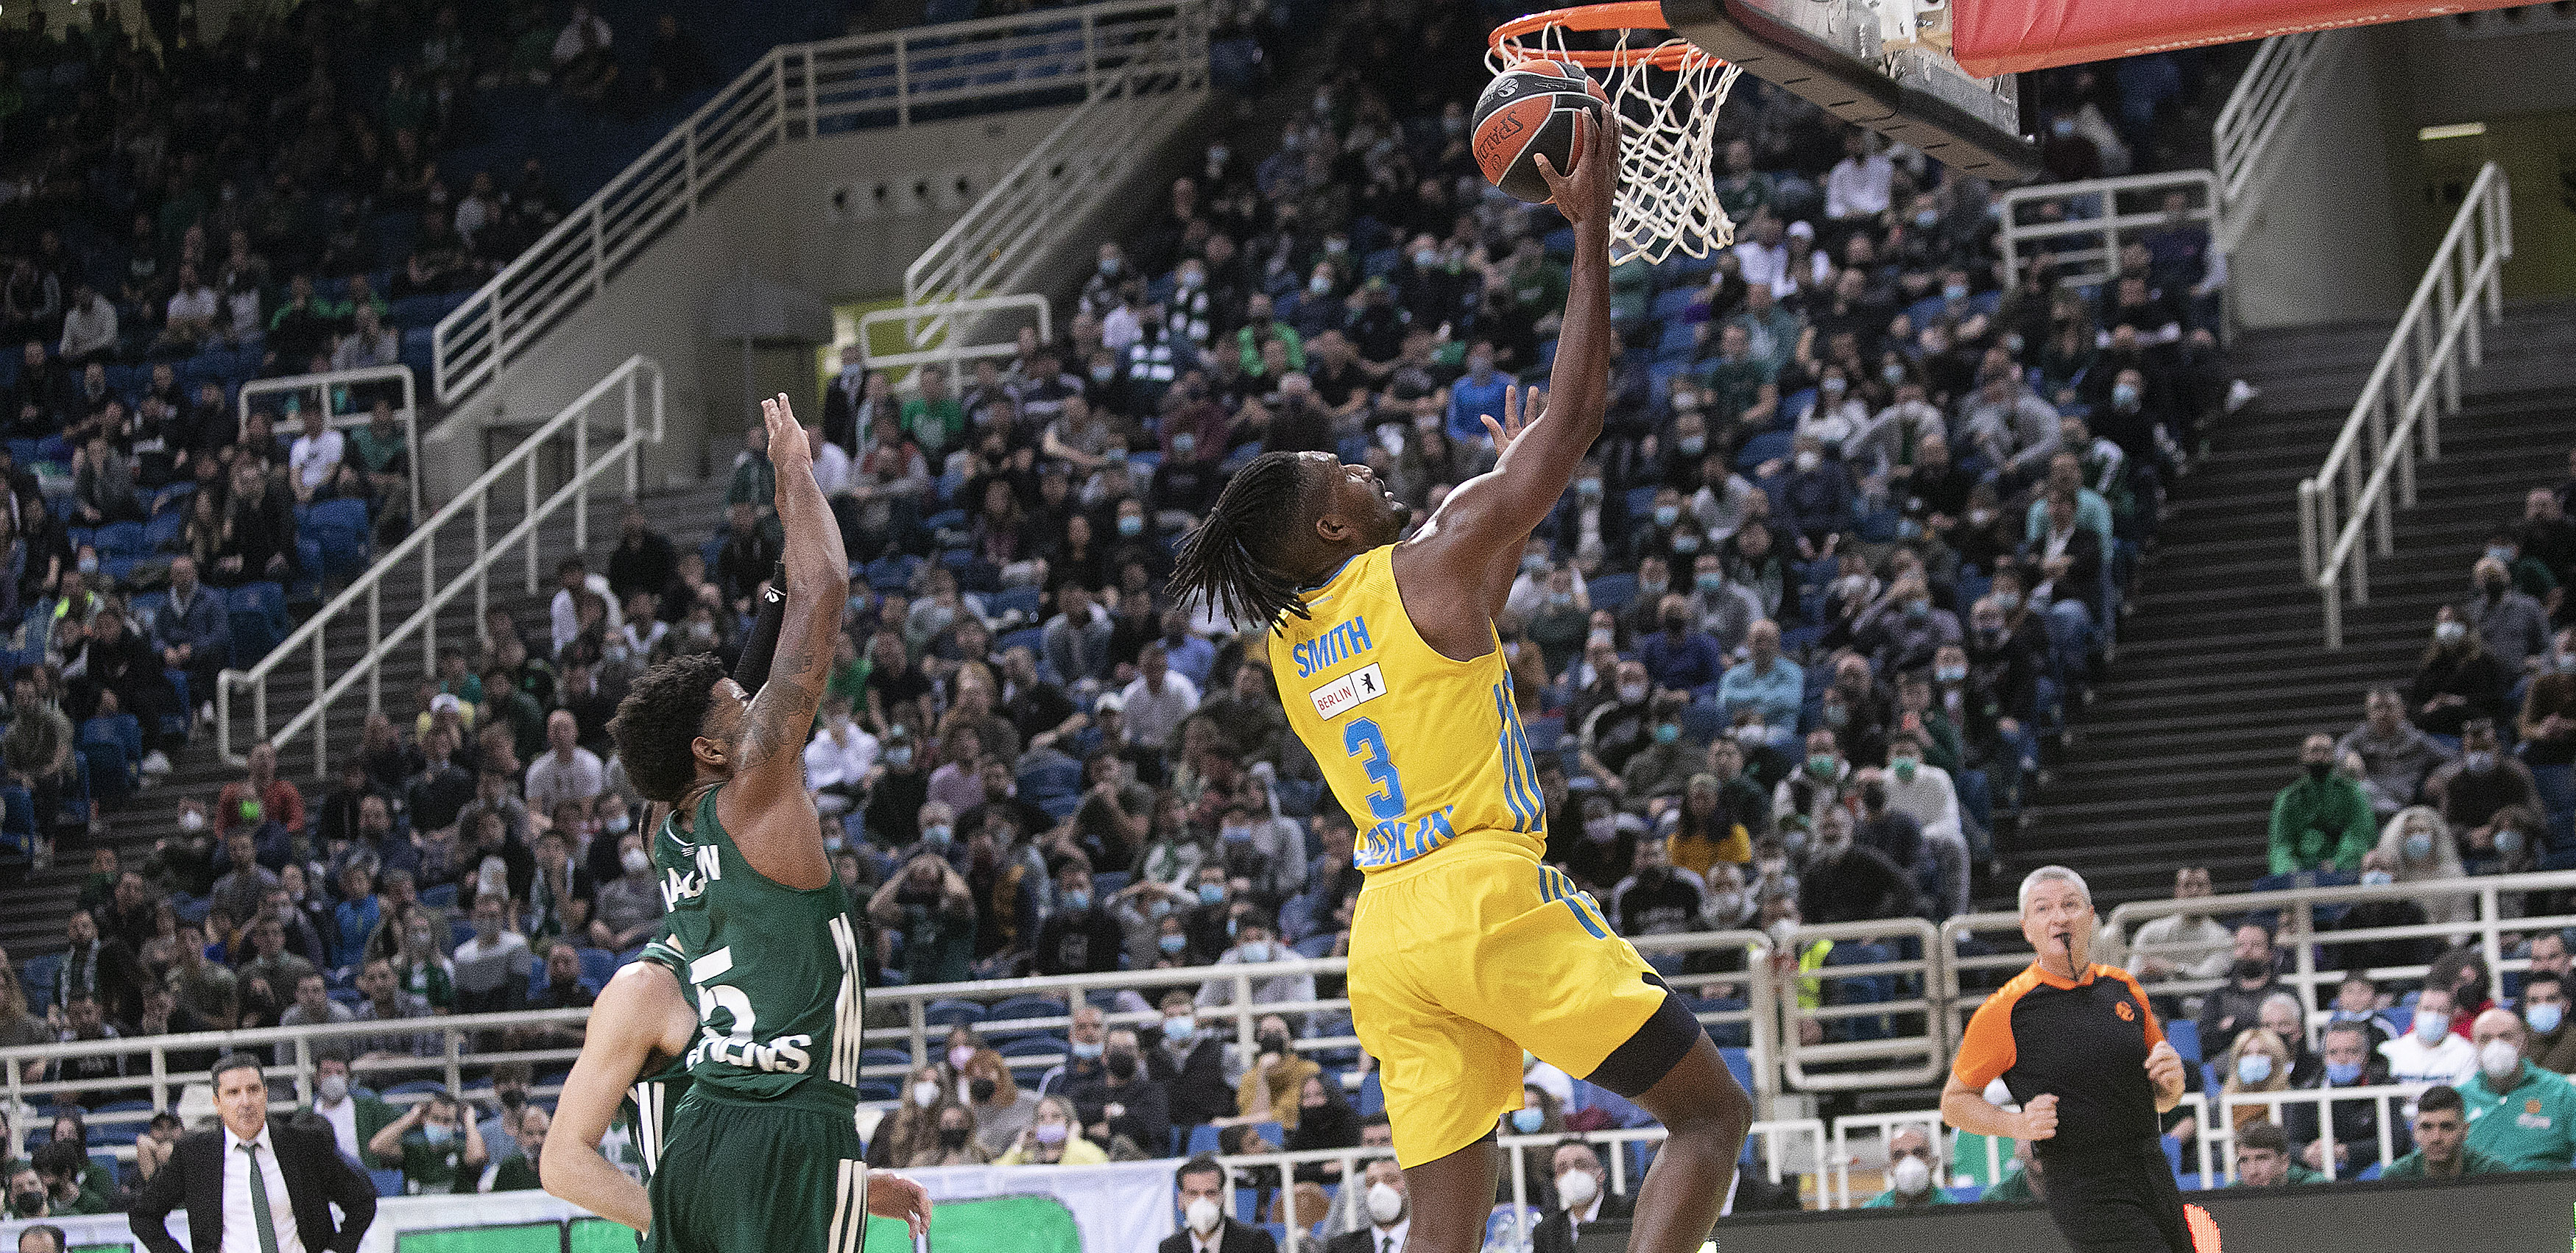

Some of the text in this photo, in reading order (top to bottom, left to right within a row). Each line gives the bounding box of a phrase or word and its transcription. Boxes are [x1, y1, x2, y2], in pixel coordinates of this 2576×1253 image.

[1292, 615, 1372, 679] SMITH
[1318, 686, 1352, 711] BERLIN
[1343, 716, 1407, 820] 3
[689, 946, 756, 1040] 5
